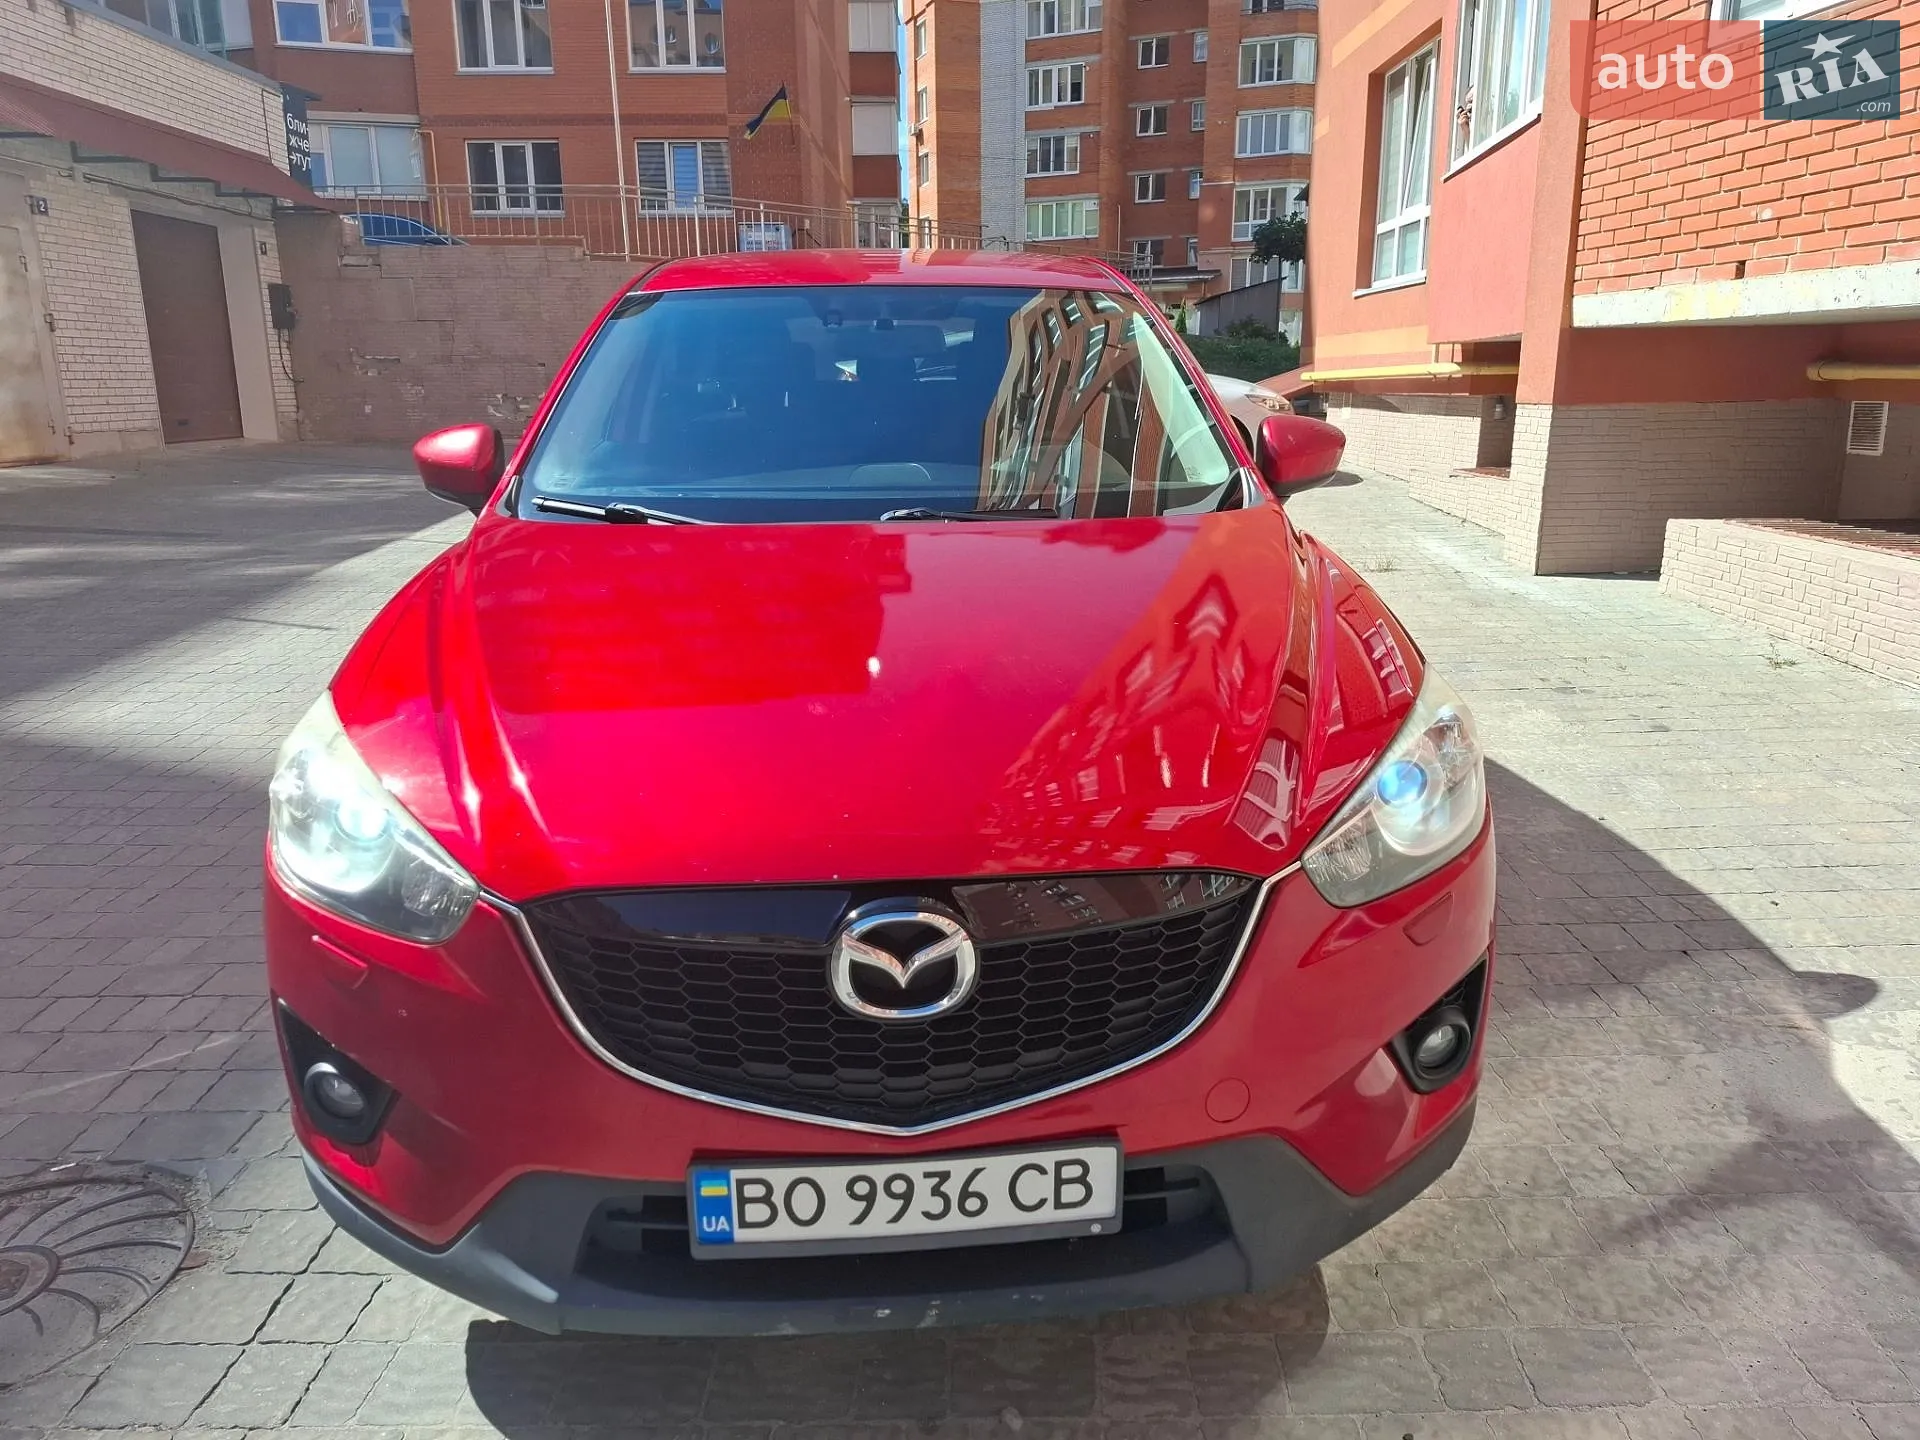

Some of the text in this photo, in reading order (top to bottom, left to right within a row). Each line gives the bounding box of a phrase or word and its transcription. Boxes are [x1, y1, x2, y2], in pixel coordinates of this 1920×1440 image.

[288, 133, 310, 152] жче
[39, 200, 46, 212] 2
[735, 1158, 1094, 1229] BO 9936 CB
[702, 1215, 730, 1232] UA
